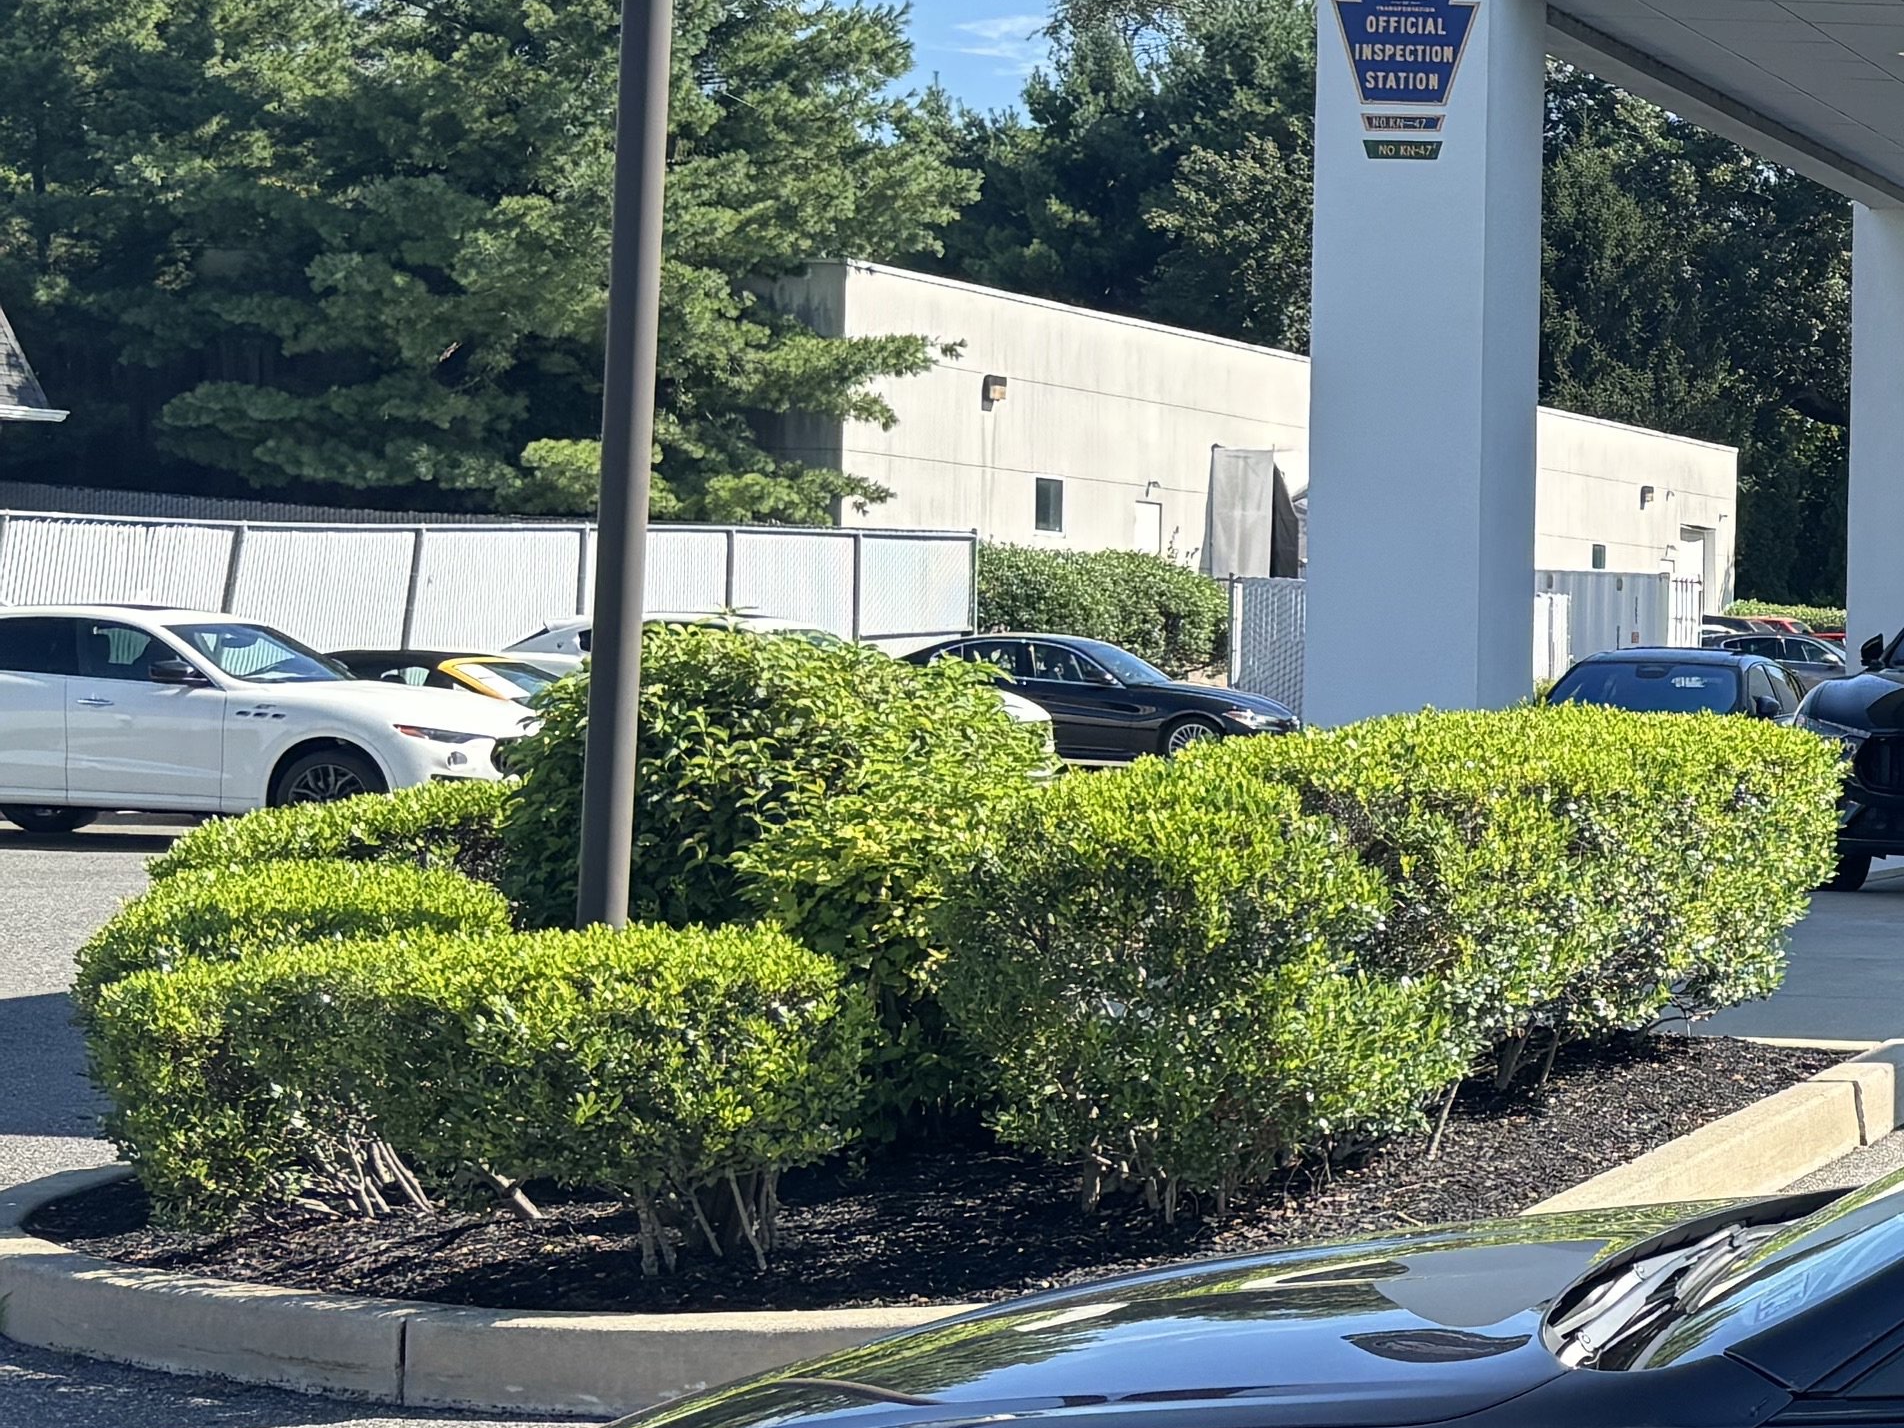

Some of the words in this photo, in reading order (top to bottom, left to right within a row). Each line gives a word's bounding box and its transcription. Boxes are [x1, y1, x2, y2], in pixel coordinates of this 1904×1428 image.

[1366, 15, 1447, 35] OFFICIAL
[1355, 43, 1453, 63] INSPECTION
[1365, 71, 1439, 90] STATION
[1378, 144, 1395, 156] NO
